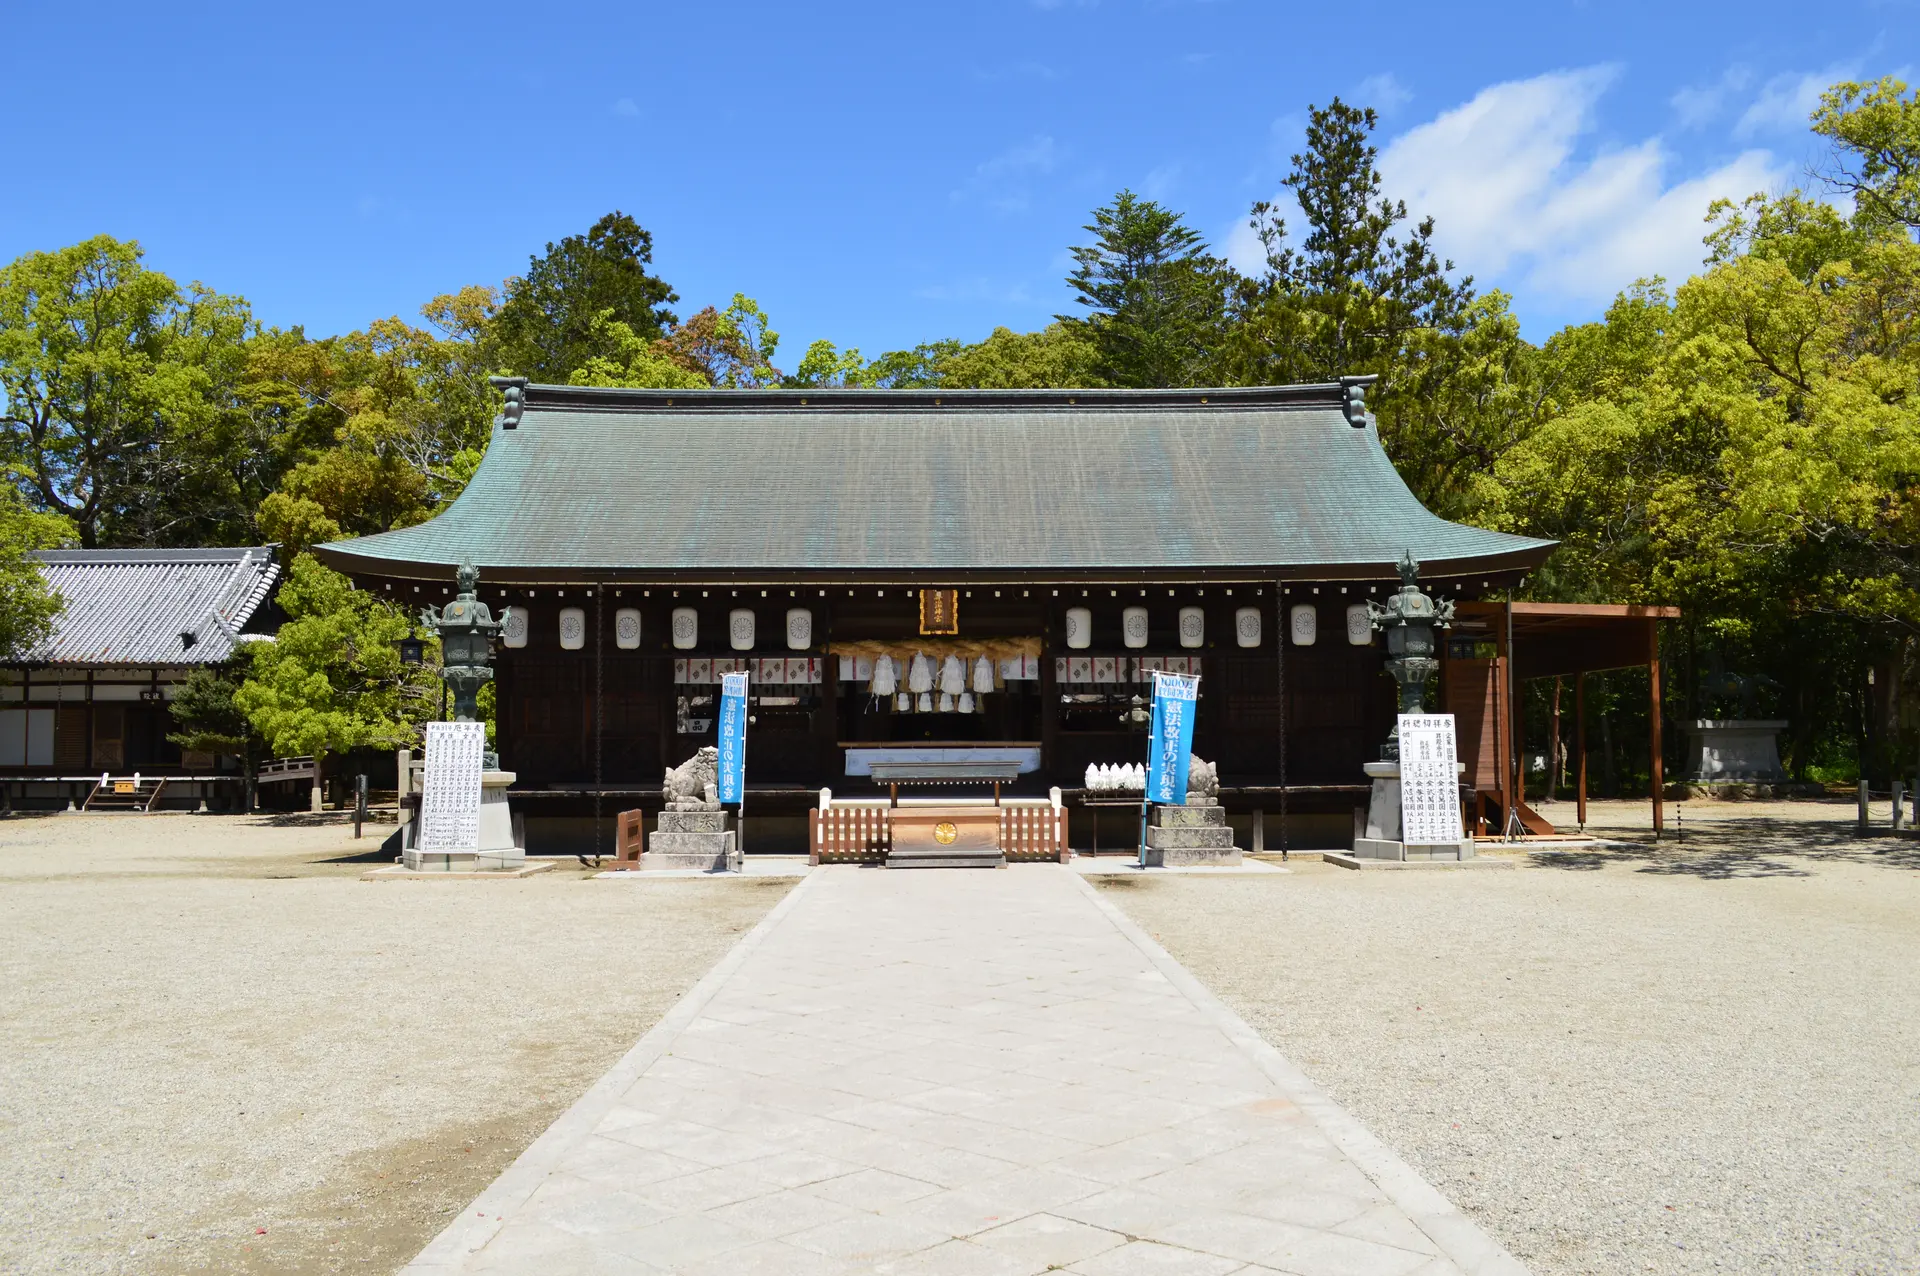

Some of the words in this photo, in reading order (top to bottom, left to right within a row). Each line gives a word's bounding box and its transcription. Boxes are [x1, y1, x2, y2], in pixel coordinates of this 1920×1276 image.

[1160, 700, 1183, 800] 憲法改正の実現を
